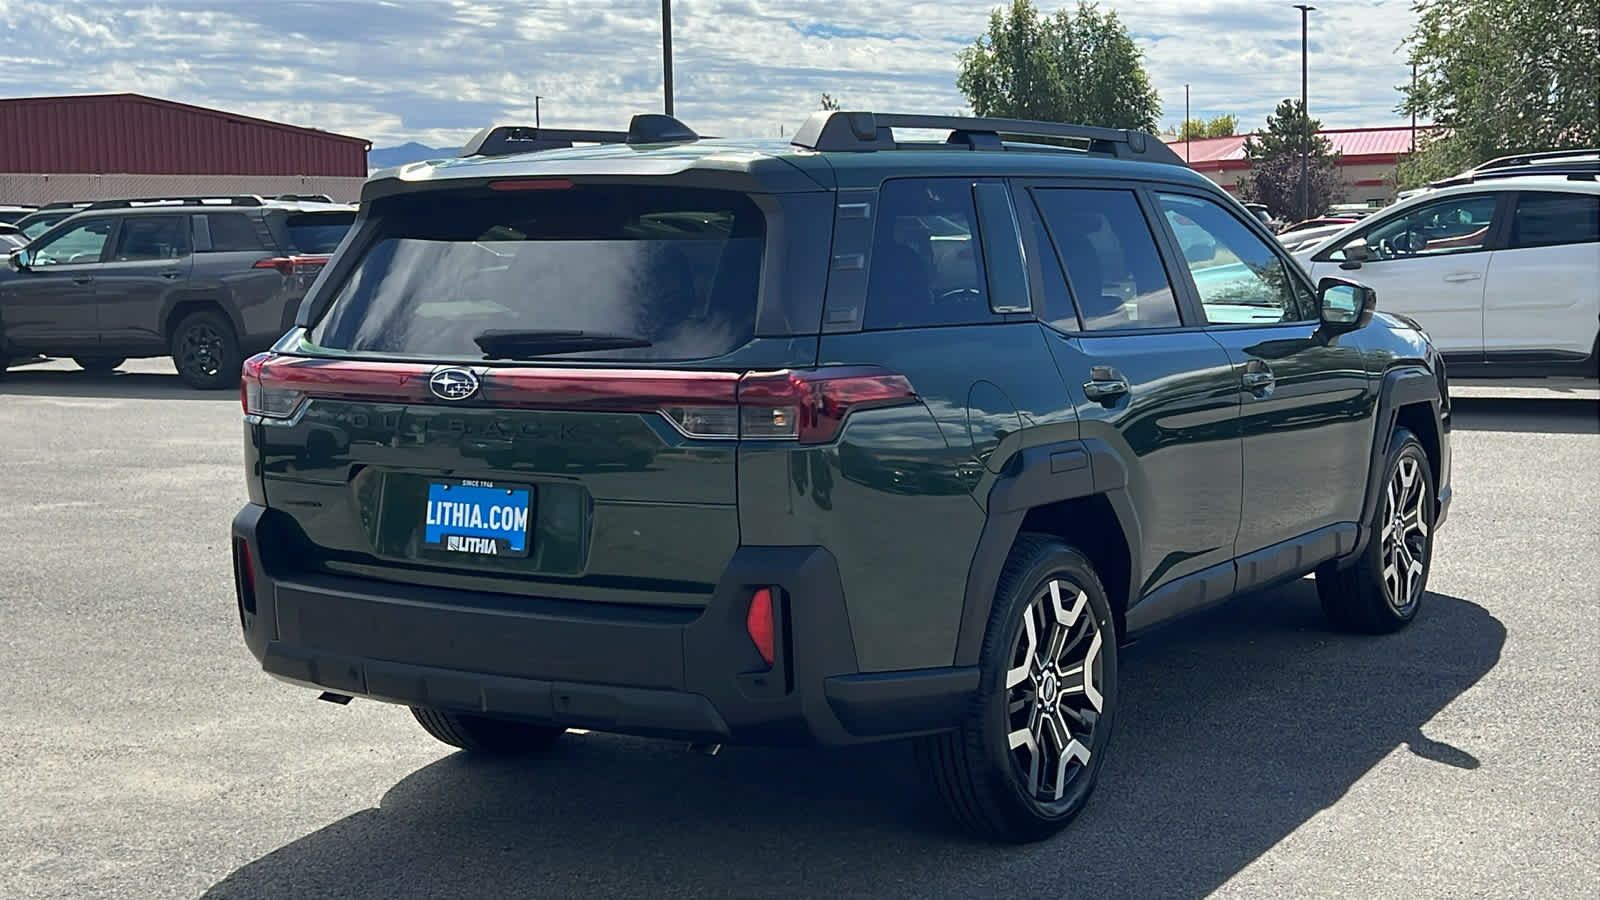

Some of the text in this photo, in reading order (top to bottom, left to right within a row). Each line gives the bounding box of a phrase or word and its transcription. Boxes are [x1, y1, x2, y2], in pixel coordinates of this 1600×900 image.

[352, 414, 577, 440] OUTBACK
[462, 479, 479, 487] SINCE
[426, 500, 528, 532] LITHIA.COM
[458, 536, 497, 555] LITHIA
